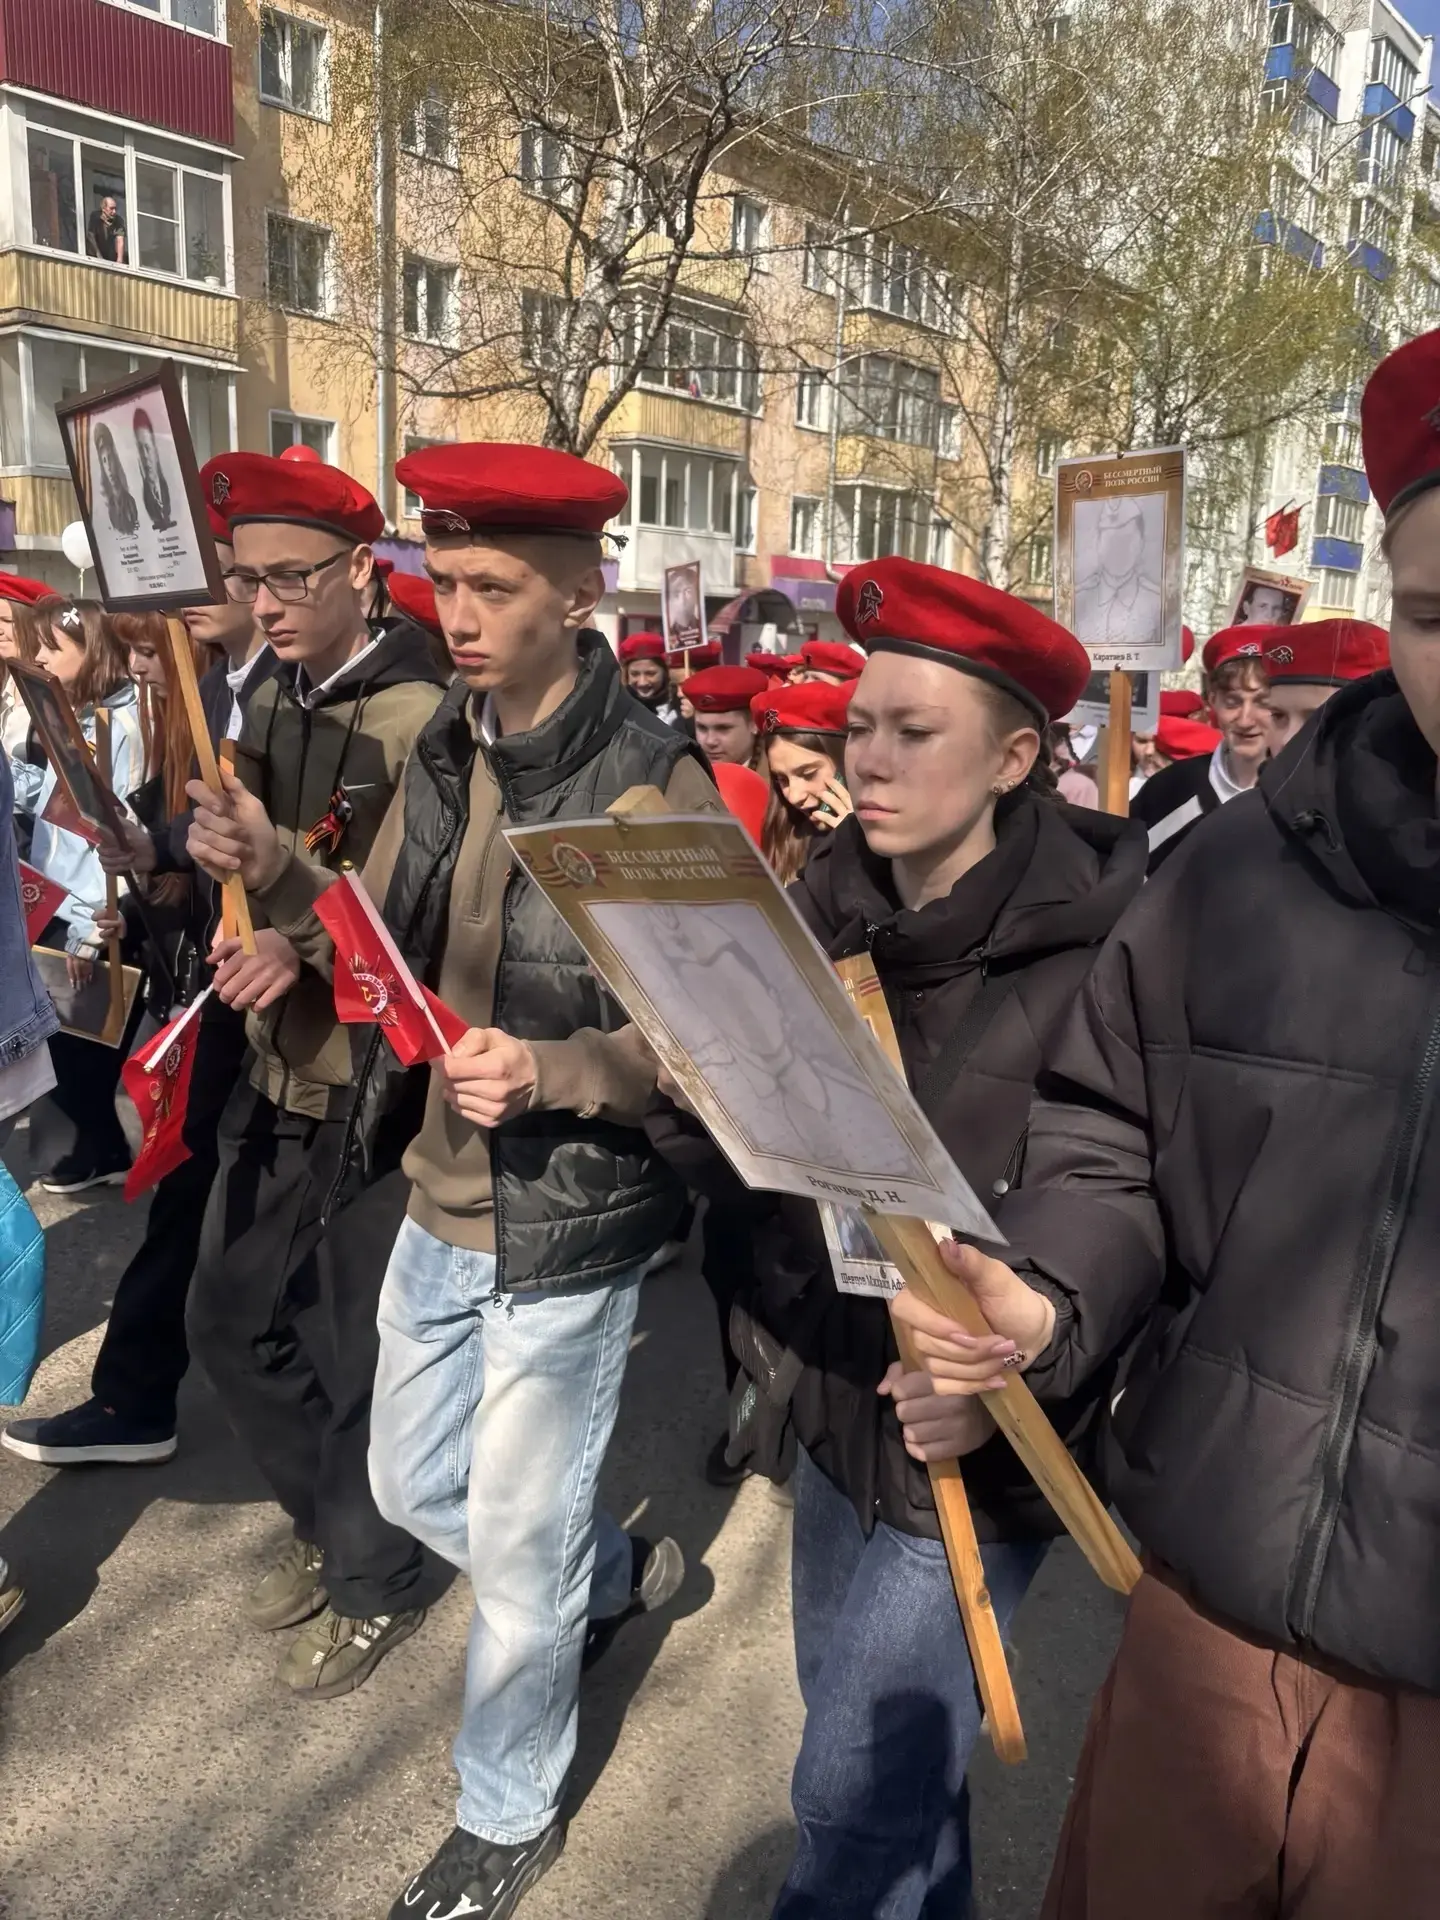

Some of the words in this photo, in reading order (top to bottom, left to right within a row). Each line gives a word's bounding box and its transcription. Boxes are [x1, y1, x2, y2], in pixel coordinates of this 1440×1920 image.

[1103, 465, 1162, 479] БЕССМЕРТНЫЙ
[1105, 479, 1126, 487] ПОЛК
[1127, 475, 1160, 485] РОССИИ
[605, 846, 720, 865] БЕССМЕРТНЫЙ
[620, 866, 662, 880] ПОЛК
[661, 865, 728, 880] РОССИИ
